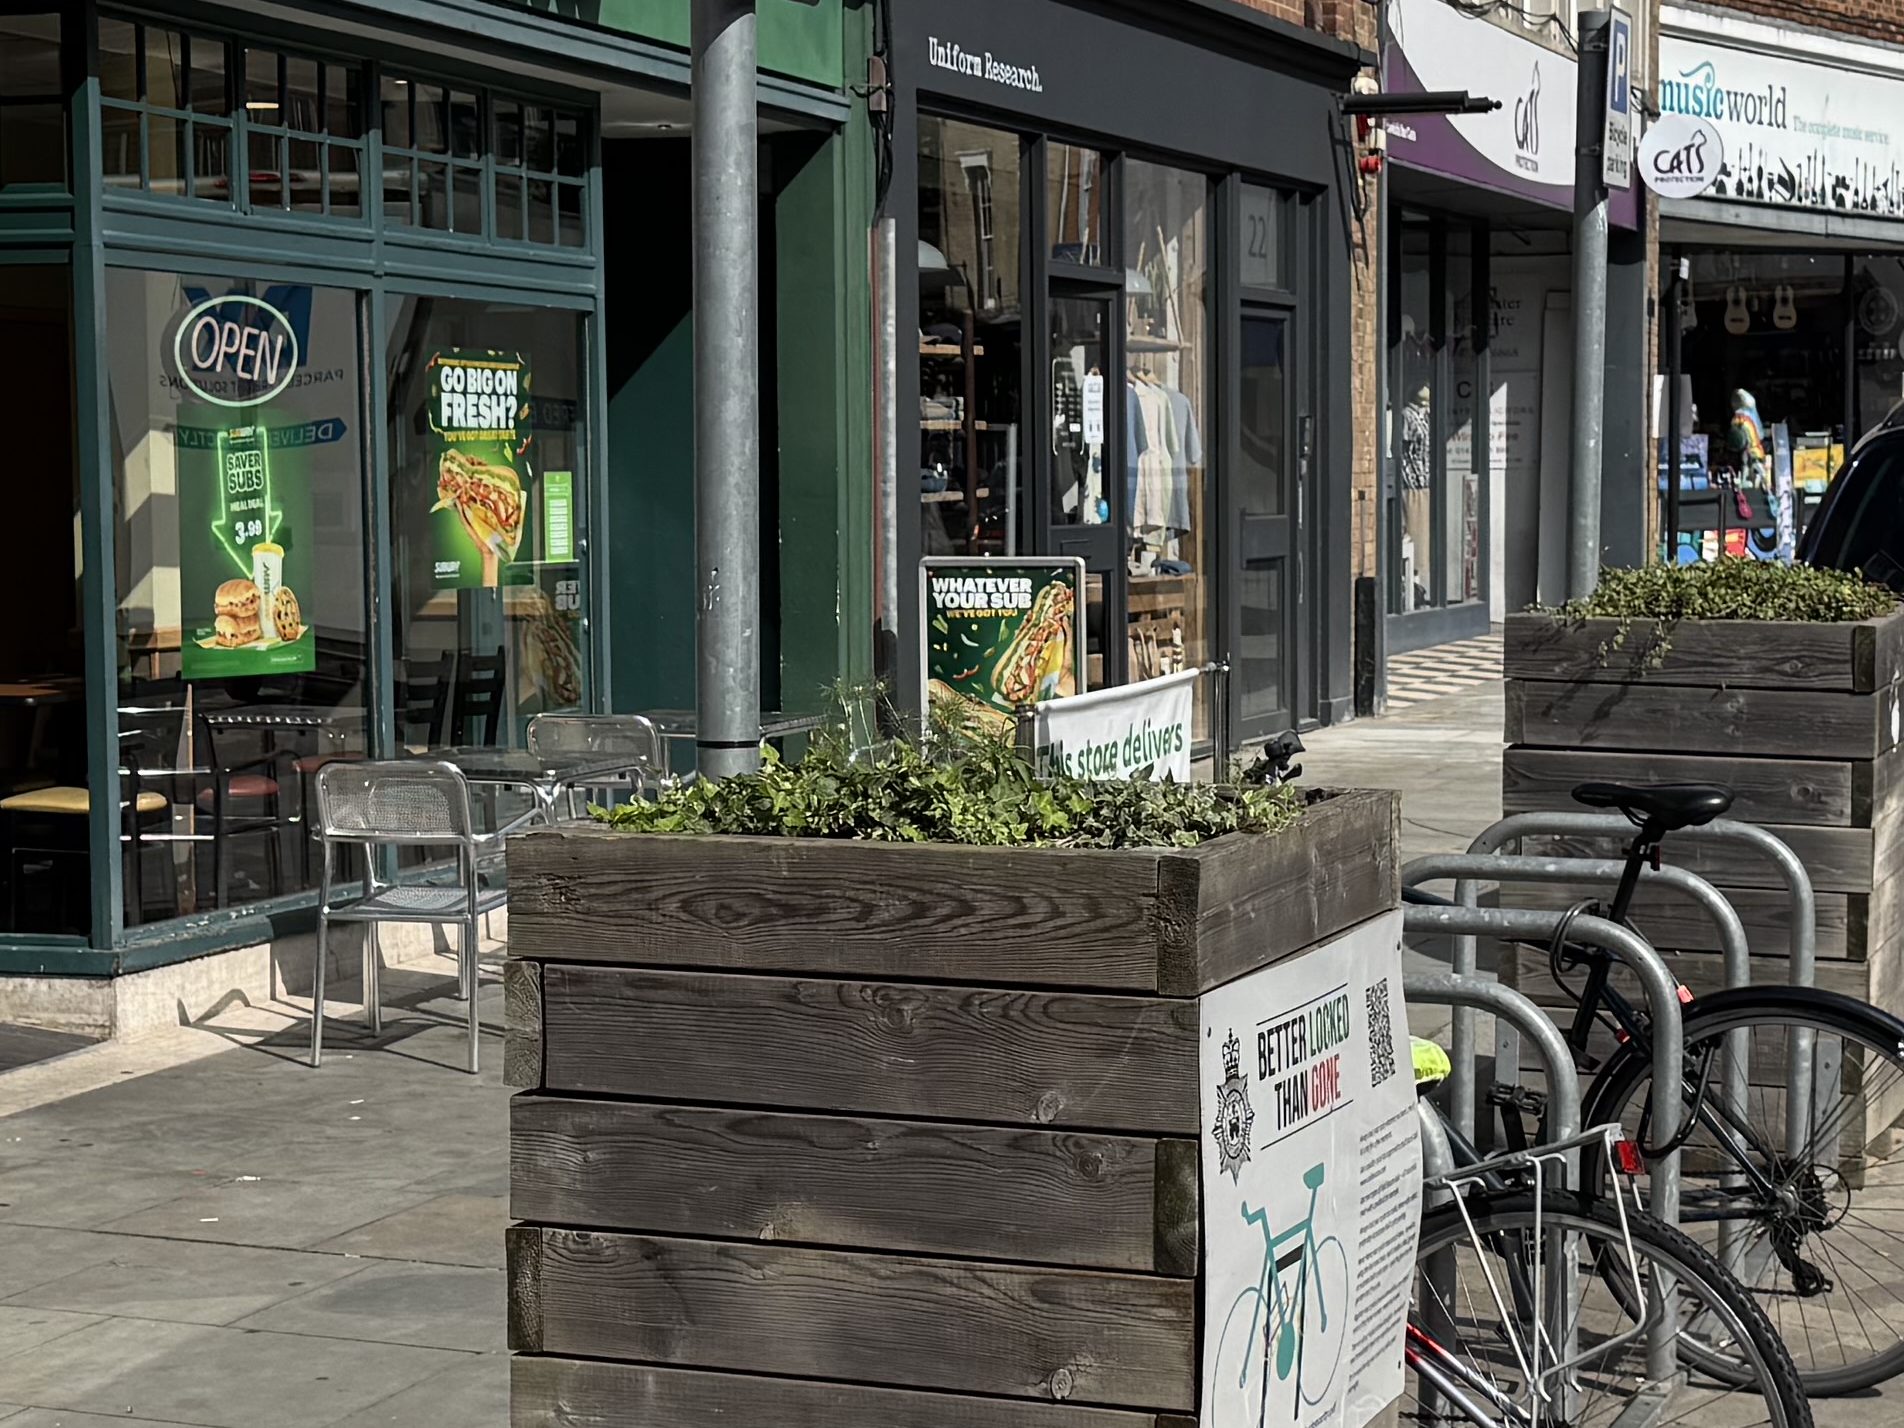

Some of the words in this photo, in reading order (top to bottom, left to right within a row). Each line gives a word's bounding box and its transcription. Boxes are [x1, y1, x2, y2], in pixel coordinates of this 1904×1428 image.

[928, 36, 982, 77] Uniform
[1614, 32, 1626, 103] P
[1653, 128, 1706, 175] CATS
[1654, 175, 1705, 184] PROTECTION
[1247, 215, 1267, 258] 22
[192, 316, 283, 384] OPEN
[440, 365, 465, 393] GO
[466, 368, 493, 394] BIG
[495, 370, 517, 395] ON
[441, 392, 517, 429] FRESH?
[226, 450, 261, 472] SAVER
[227, 469, 263, 493] SUBS
[235, 519, 263, 545] 3.99
[932, 578, 1032, 593] WHATEVER
[932, 592, 988, 609] YOUR
[990, 592, 1032, 609] SUB
[975, 609, 995, 618] GOT
[1037, 740, 1072, 778] This
[1078, 739, 1118, 778] store
[1122, 717, 1183, 768] delivers
[1258, 1014, 1307, 1081] BETTER
[1309, 994, 1350, 1057] LOCKED
[1274, 1070, 1308, 1130] THAN
[1311, 1053, 1341, 1112] GONE
